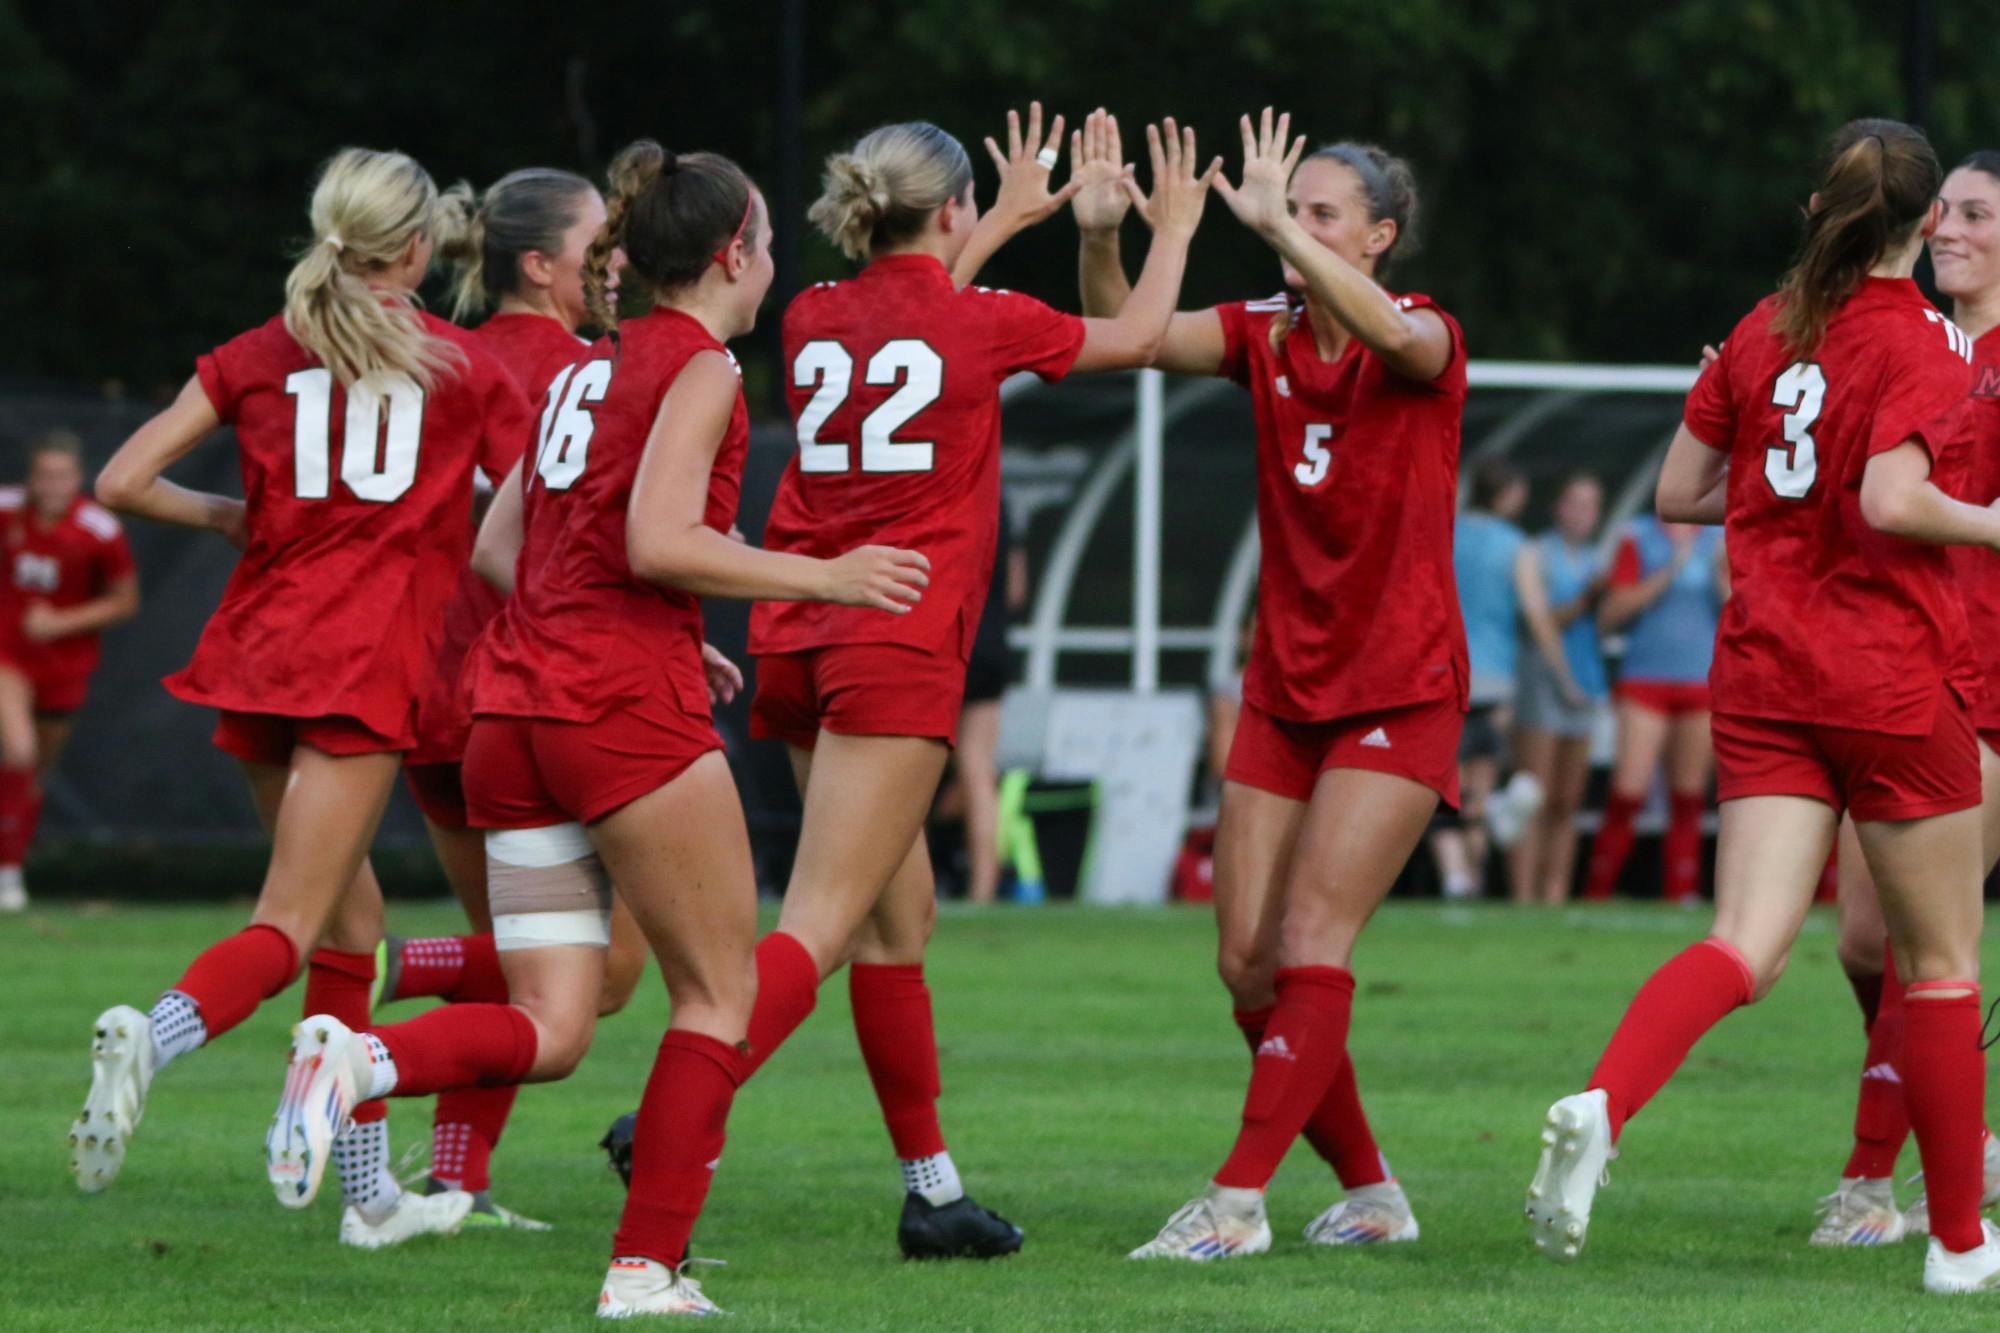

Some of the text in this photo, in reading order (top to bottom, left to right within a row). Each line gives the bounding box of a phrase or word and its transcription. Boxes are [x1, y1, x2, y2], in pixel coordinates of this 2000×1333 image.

[283, 366, 426, 504] 10
[793, 338, 944, 472] 22
[1293, 423, 1333, 487] 5
[1763, 361, 1828, 499] 3
